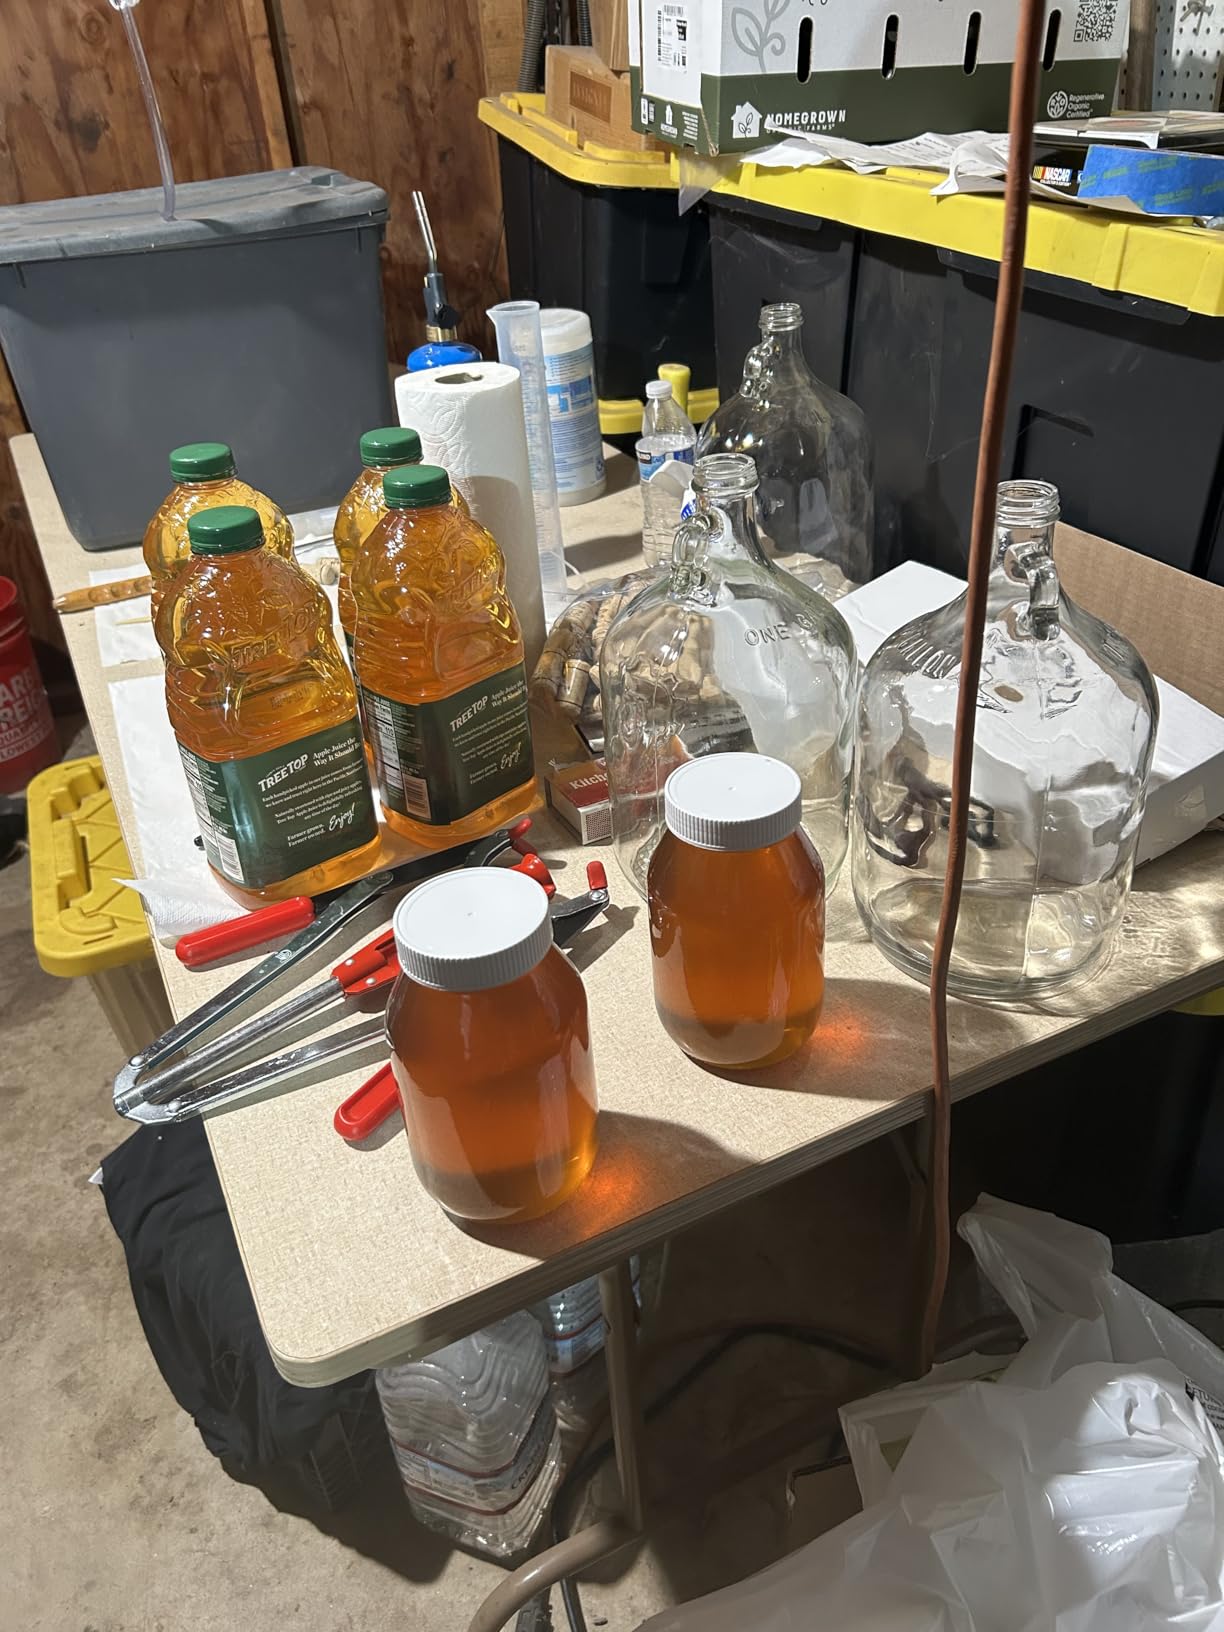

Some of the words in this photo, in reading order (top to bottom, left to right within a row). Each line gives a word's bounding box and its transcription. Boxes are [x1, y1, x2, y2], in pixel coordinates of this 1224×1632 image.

[1069, 93, 1104, 103] Regenerative
[1066, 110, 1091, 118] Certified
[1068, 102, 1090, 111] Organic
[766, 109, 846, 126] HOMEGROWN
[1044, 166, 1071, 182] NASCAR
[744, 622, 792, 646] ONE
[313, 747, 330, 760] Apple
[331, 743, 346, 752] Juice
[347, 737, 356, 746] the
[314, 760, 328, 768] Way
[328, 754, 334, 762] It
[334, 746, 354, 759] Should
[328, 802, 356, 832] Enjoy!
[287, 831, 306, 840] Farmer
[288, 837, 306, 846] Farmer
